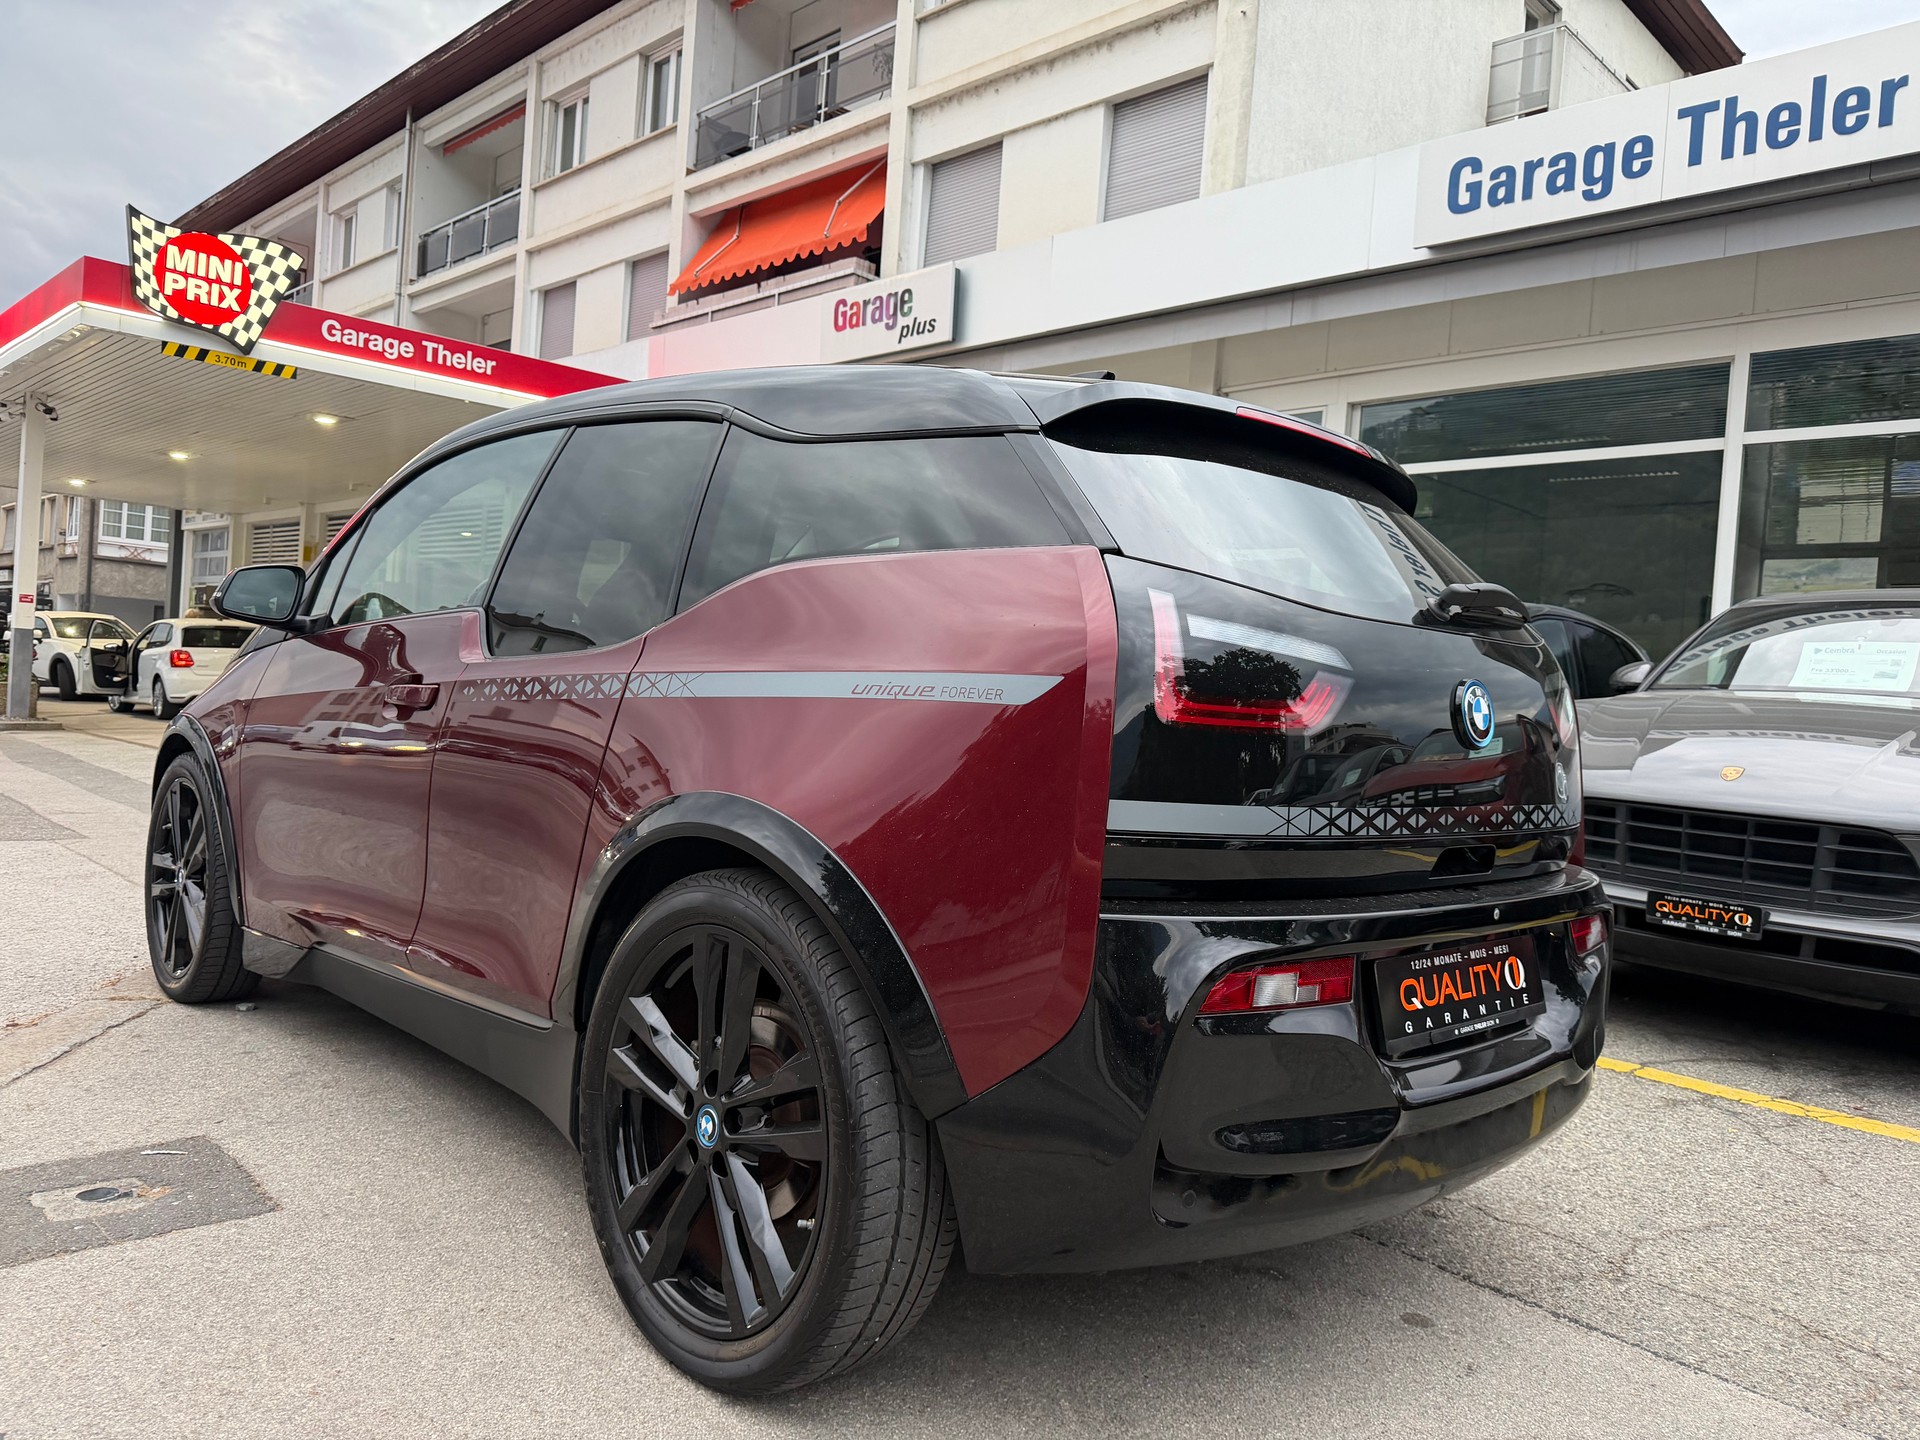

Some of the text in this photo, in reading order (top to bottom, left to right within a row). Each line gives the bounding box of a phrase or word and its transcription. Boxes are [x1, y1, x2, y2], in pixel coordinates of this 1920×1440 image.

[1446, 73, 1910, 215] Garage Theler
[165, 244, 243, 287] MINI
[163, 271, 242, 312] PRIX
[833, 288, 914, 333] Garage
[898, 317, 937, 344] plus
[321, 319, 497, 376] Garage Theler
[1824, 647, 1855, 655] Cembra
[851, 682, 1004, 701] unique FOREVER
[1655, 900, 1734, 922] QUALITY
[1655, 911, 1751, 933] GARANTIE
[1662, 919, 1743, 938] GARAGE THELER SION
[1410, 959, 1431, 970] 12/24
[1434, 953, 1463, 966] MONATE
[1469, 948, 1487, 959] MOIS
[1493, 944, 1510, 955] MESI
[1399, 961, 1502, 1011] QUALITY
[1404, 993, 1530, 1033] GARANTIE
